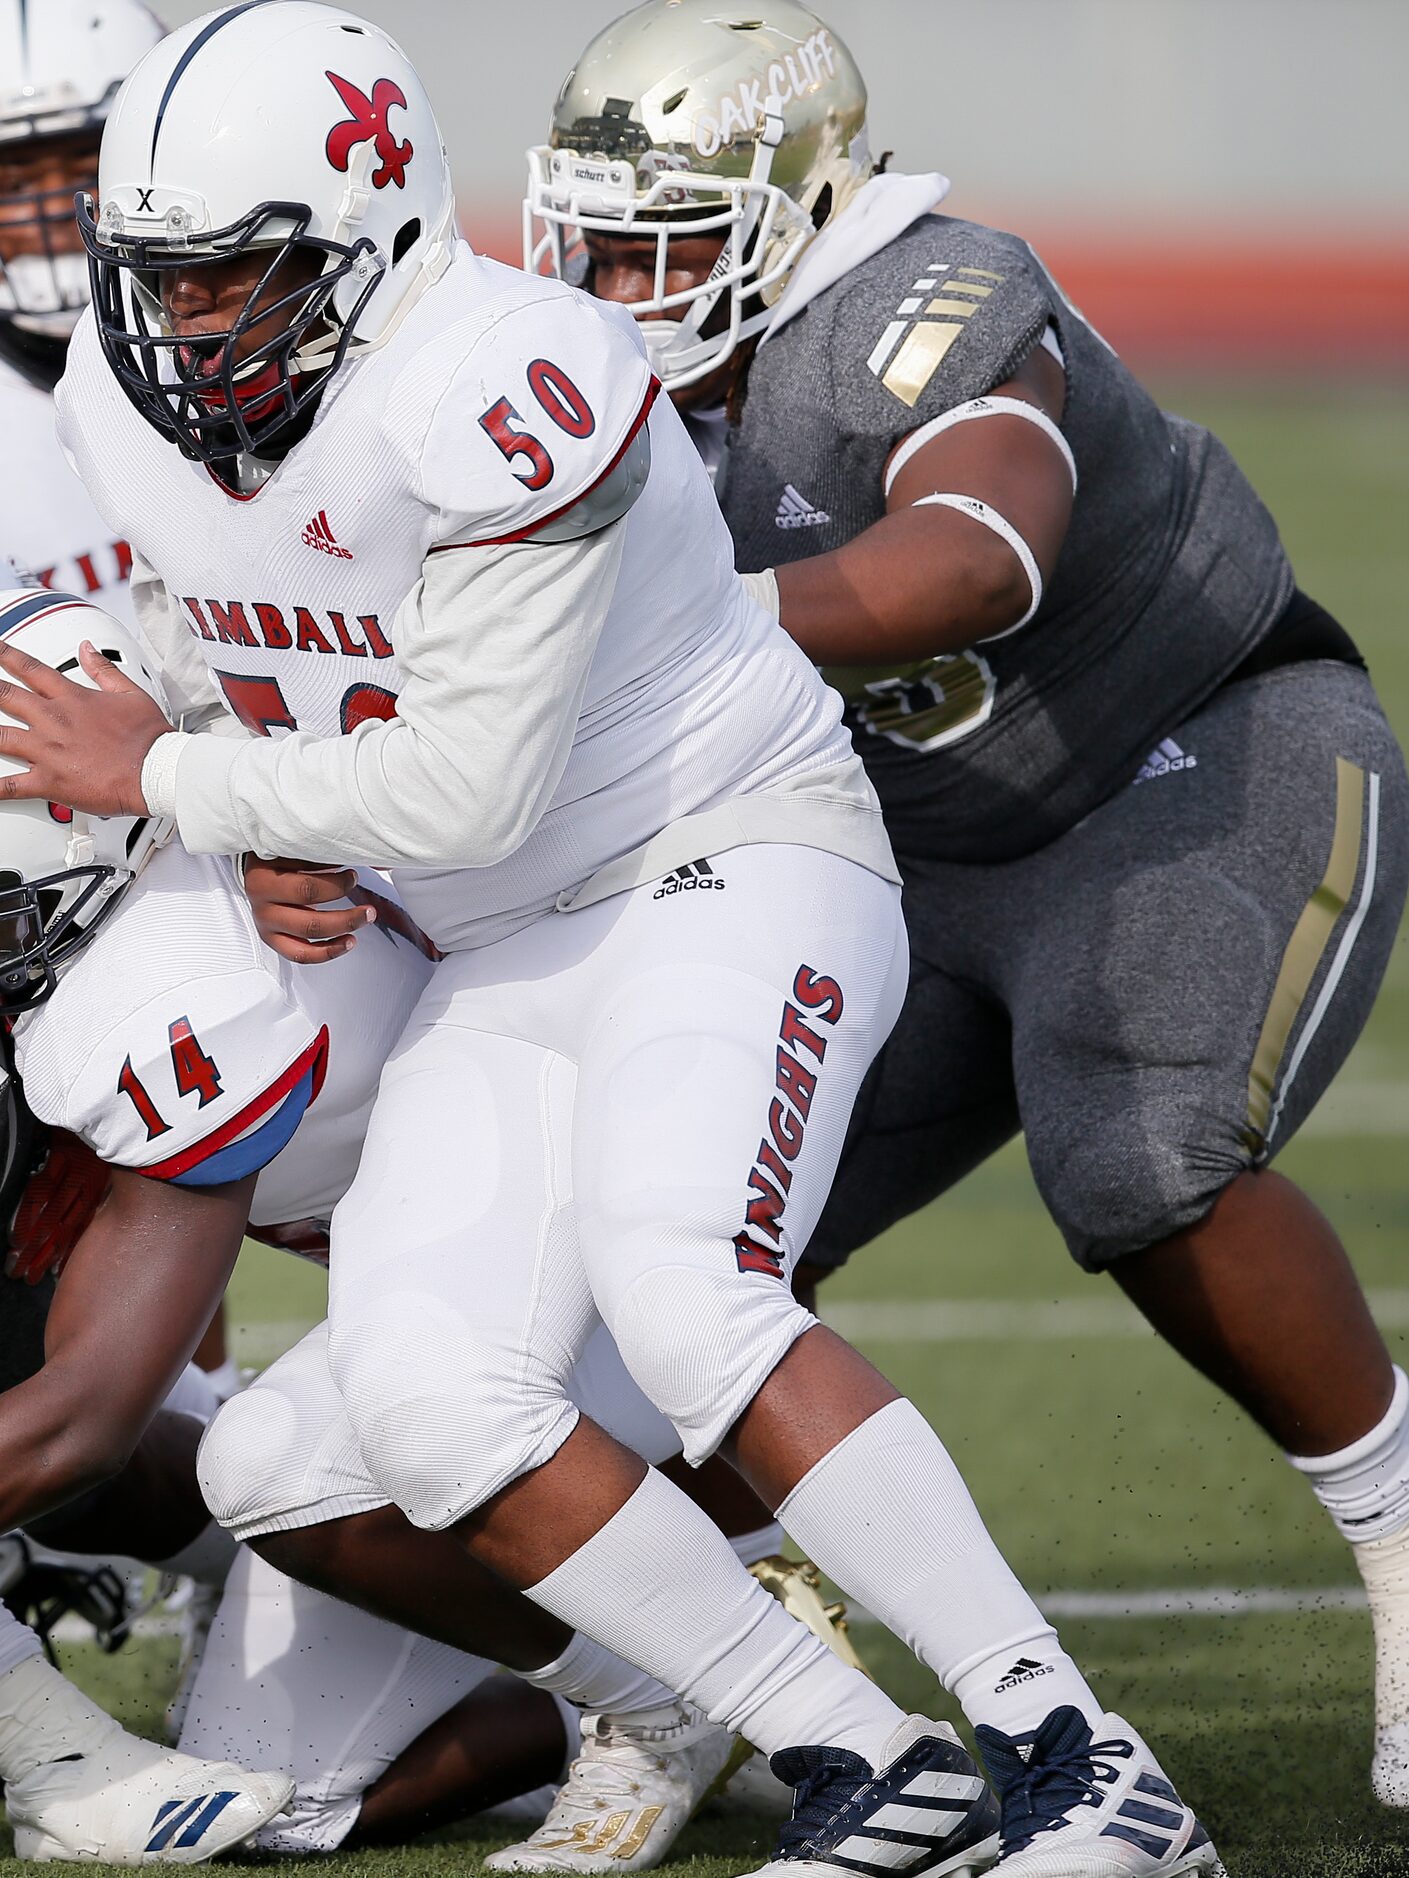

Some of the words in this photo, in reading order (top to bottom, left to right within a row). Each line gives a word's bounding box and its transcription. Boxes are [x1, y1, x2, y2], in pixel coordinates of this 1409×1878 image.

[696, 79, 765, 157] OAK
[768, 29, 836, 101] CLIFF
[478, 359, 596, 492] 50
[301, 533, 353, 559] adidas
[775, 511, 830, 530] adidas
[174, 595, 394, 660] IMBALL
[653, 876, 725, 900] adidas
[116, 1014, 225, 1142] 14
[732, 963, 844, 1280] KNIGHTS
[994, 1664, 1055, 1694] adidas
